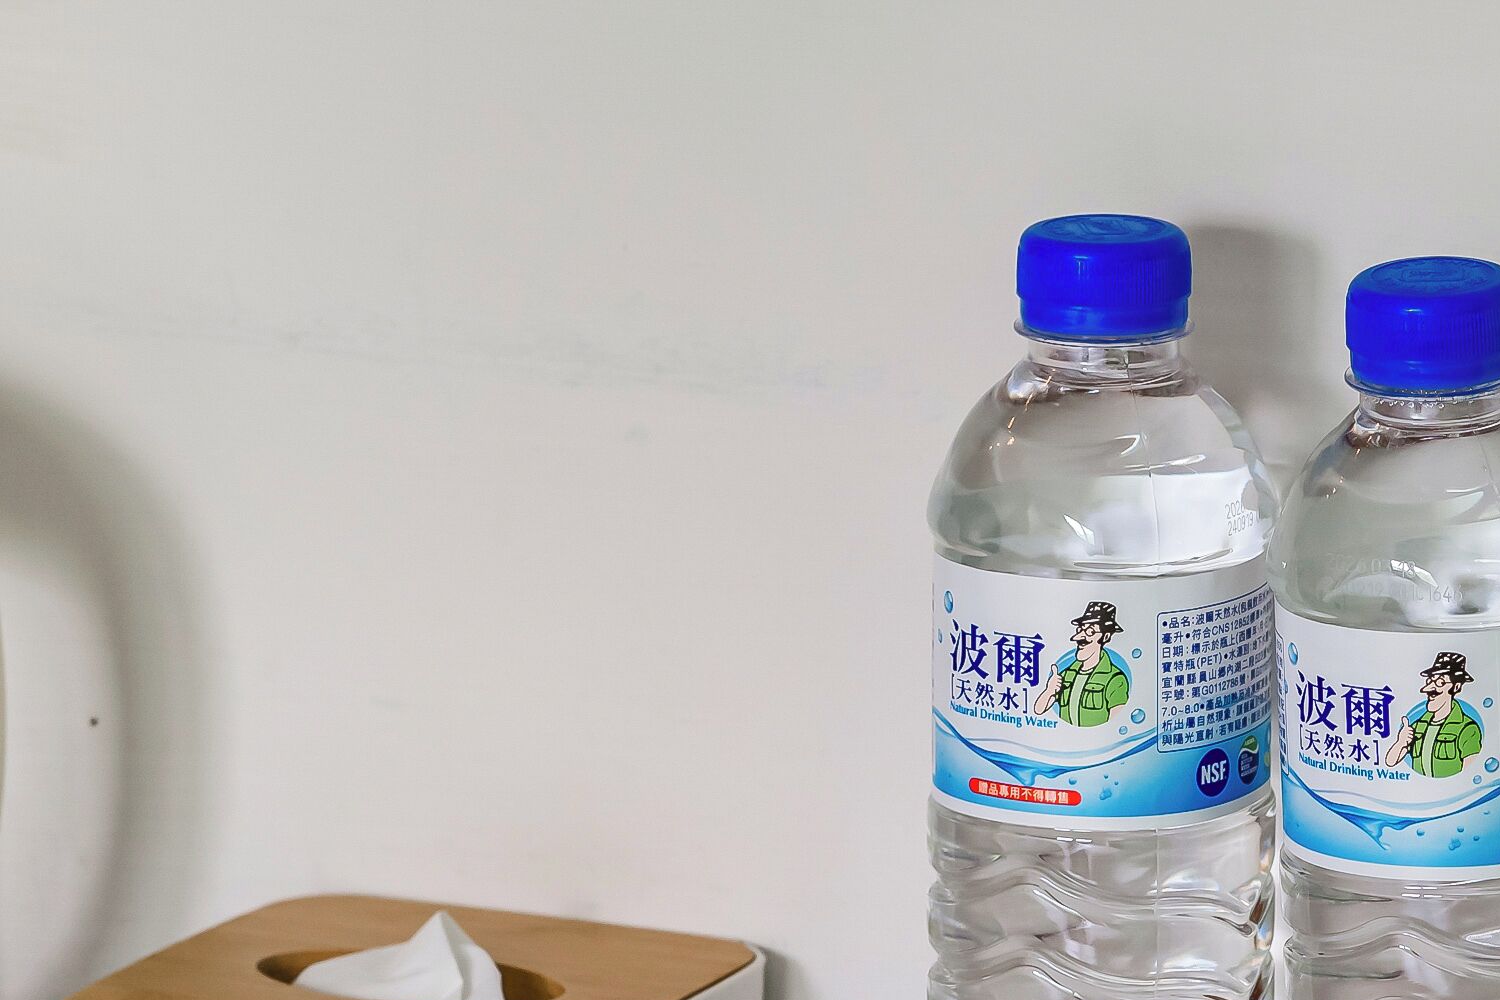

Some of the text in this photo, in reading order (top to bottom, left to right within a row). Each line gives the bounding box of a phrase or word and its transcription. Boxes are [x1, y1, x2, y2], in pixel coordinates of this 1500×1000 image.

[950, 619, 1045, 687] 波爾
[950, 700, 1059, 729] Natural Drinking Water
[1296, 669, 1395, 739] 波爾
[1201, 759, 1227, 785] NSF
[1299, 752, 1411, 781] Natural Drinking Water
